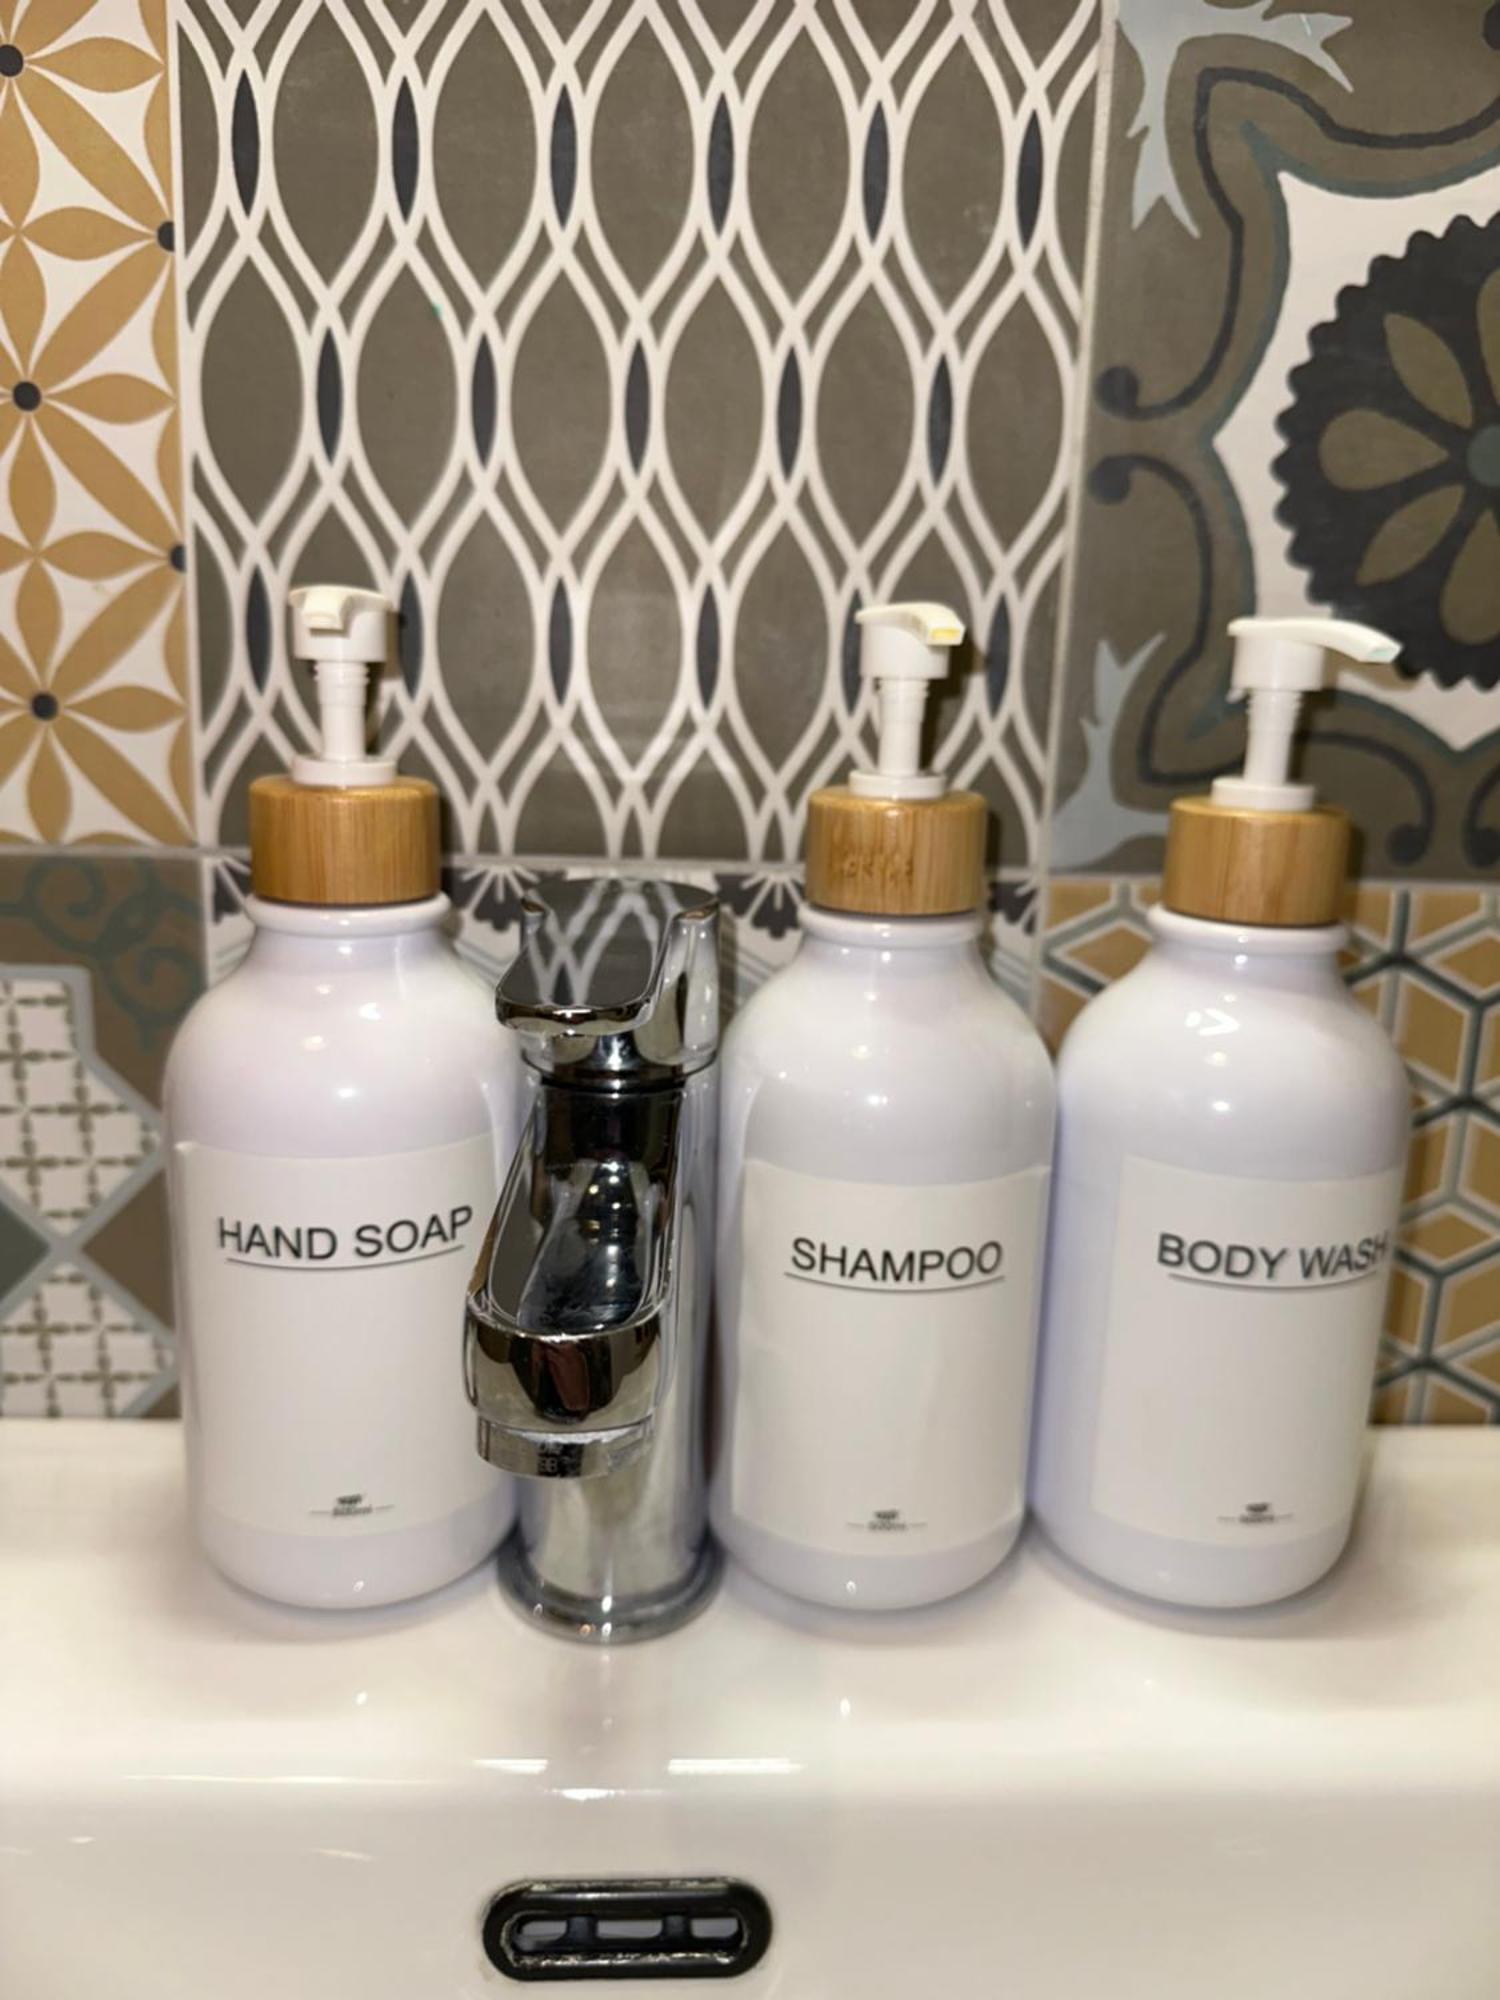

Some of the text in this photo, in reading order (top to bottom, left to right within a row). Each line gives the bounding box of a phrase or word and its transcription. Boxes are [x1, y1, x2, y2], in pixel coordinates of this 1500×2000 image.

[217, 1205, 473, 1260] HAND SOAP
[1157, 1231, 1389, 1279] BODY WASH
[791, 1236, 1003, 1282] SHAMPOO
